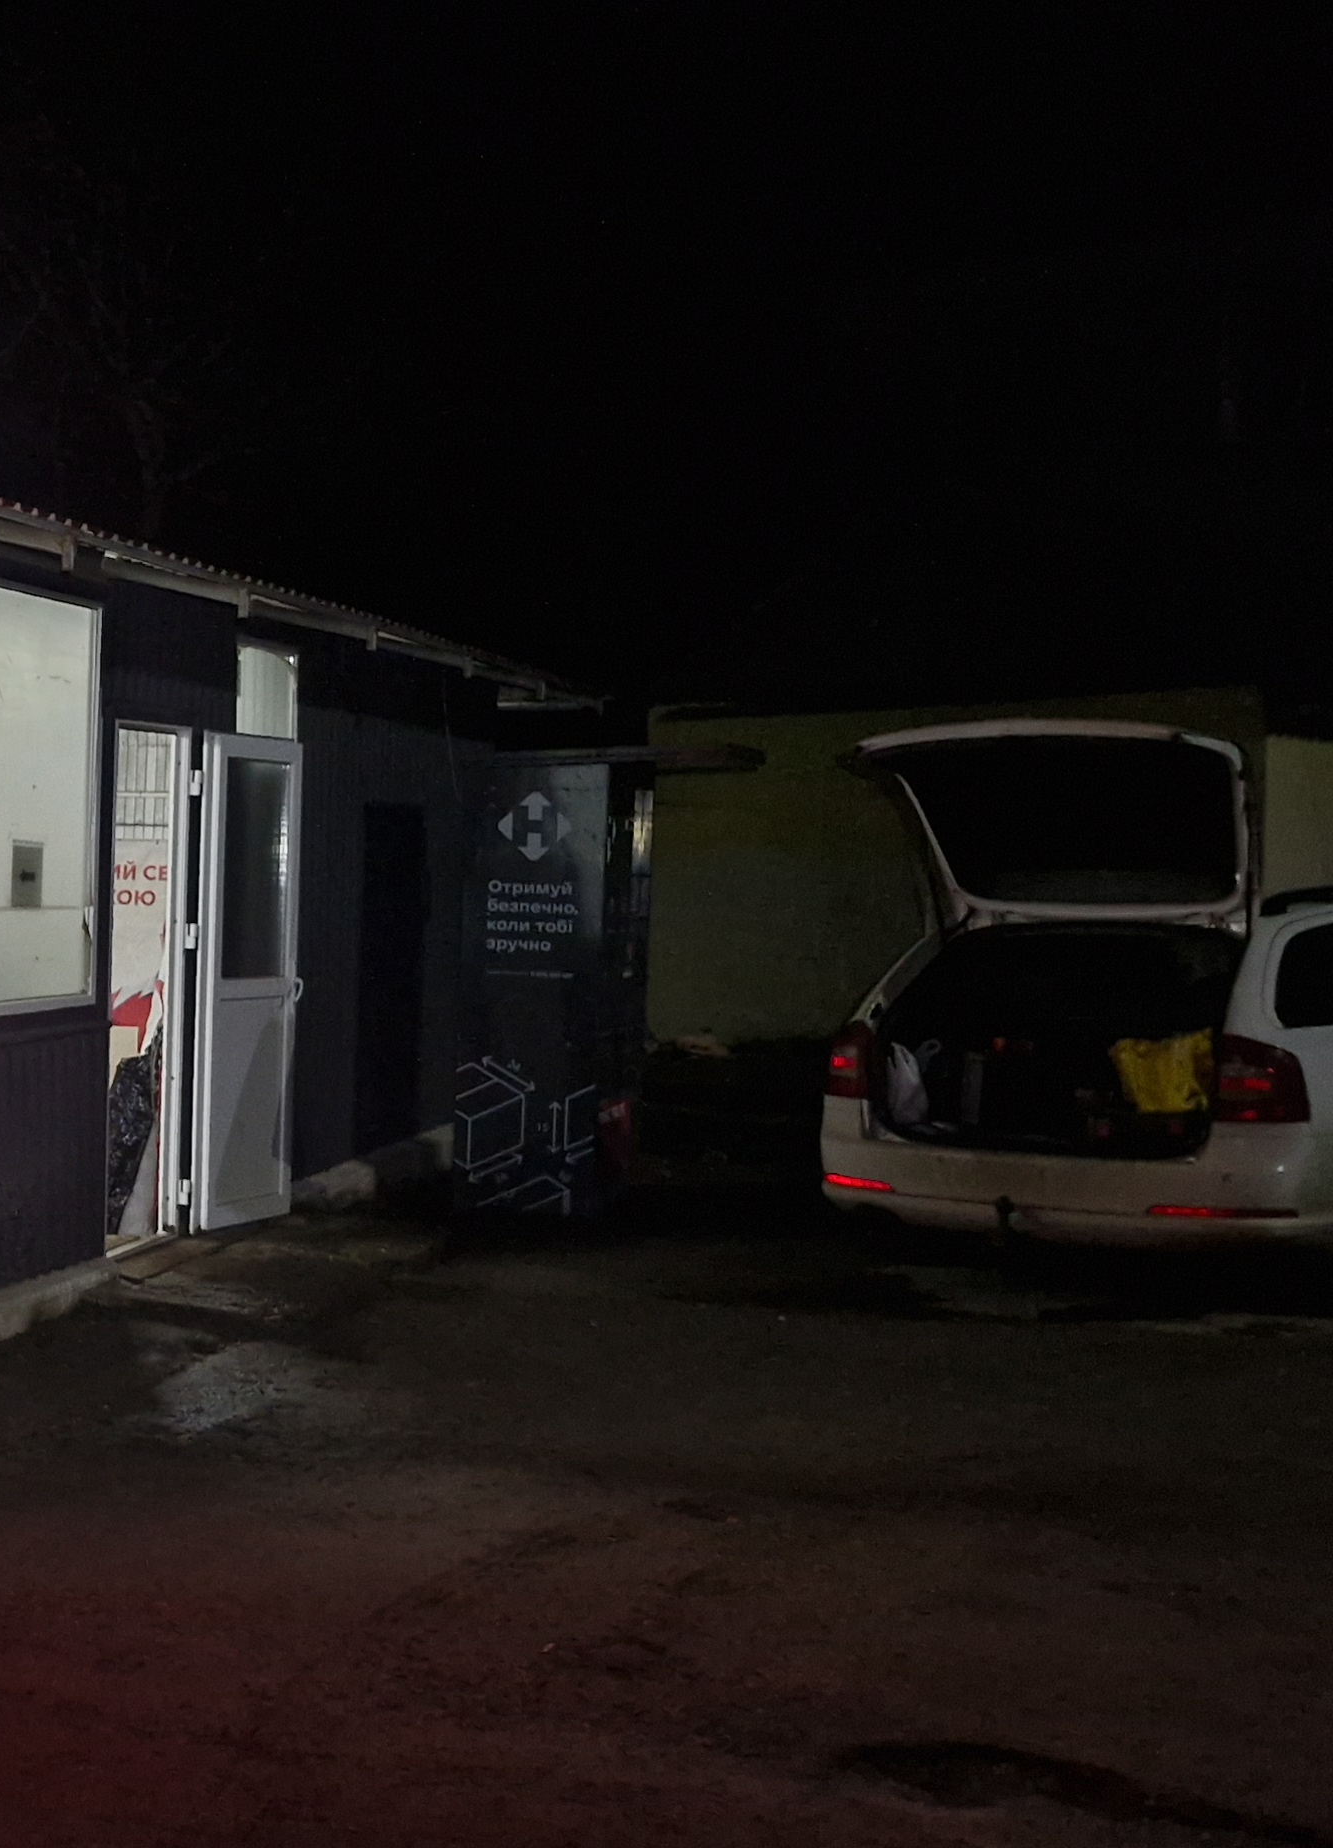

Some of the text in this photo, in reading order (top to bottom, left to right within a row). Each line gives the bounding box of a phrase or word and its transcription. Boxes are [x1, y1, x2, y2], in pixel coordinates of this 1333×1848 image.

[487, 880, 573, 898] Отримуй
[115, 890, 156, 906] ОЮ
[486, 897, 580, 915] безпечно,
[486, 919, 574, 934] коли тобі
[485, 938, 552, 953] зручно
